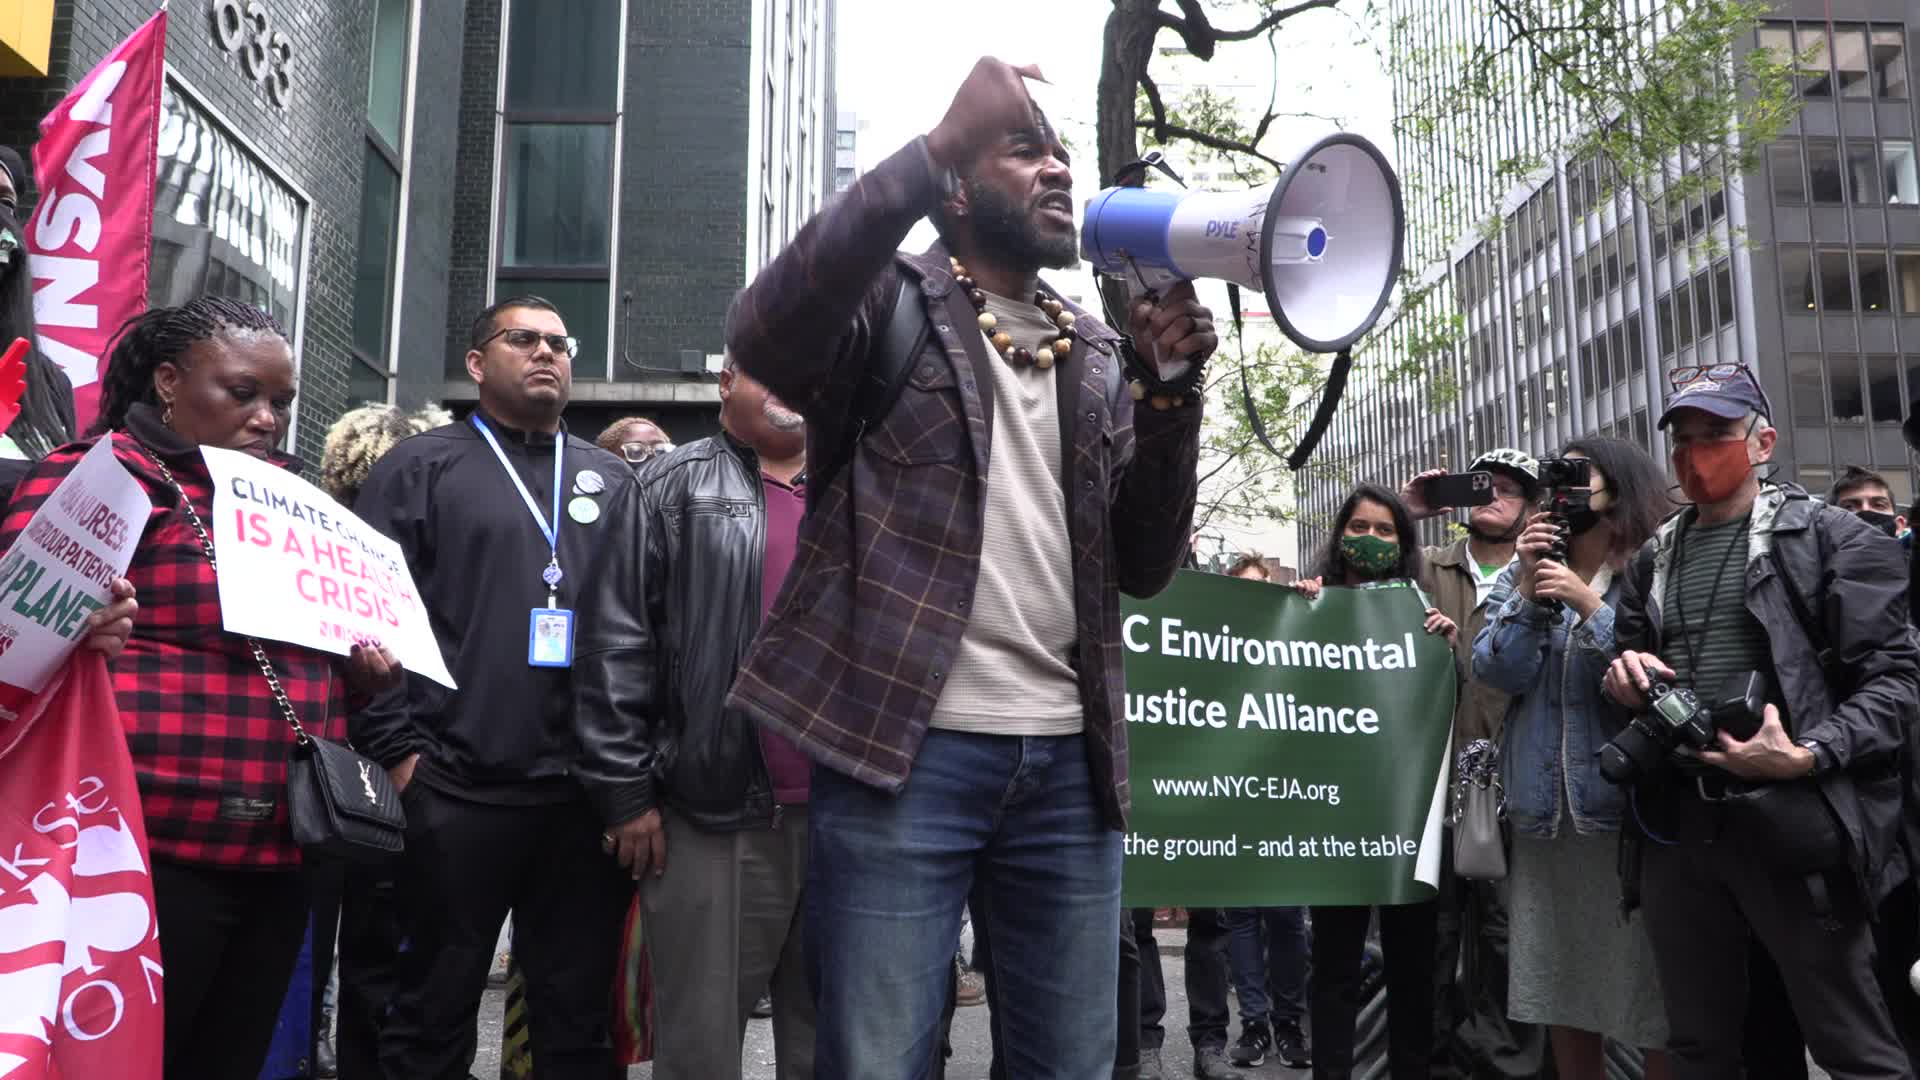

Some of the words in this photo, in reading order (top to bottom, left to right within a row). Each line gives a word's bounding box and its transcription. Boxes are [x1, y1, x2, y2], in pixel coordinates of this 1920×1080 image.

[1205, 219, 1239, 239] PYLE
[231, 477, 332, 532] CLIMATE
[235, 509, 272, 547] IS
[283, 527, 305, 558] A
[1, 560, 104, 641] PLANET
[296, 568, 399, 627] CRISIS
[1122, 614, 1150, 653] C
[1161, 617, 1417, 670] Environmental
[1123, 687, 1227, 728] ustice
[1237, 693, 1380, 734] Alliance
[1152, 775, 1341, 806] www.NYC-EJA.org
[1122, 831, 1159, 856] the
[1163, 833, 1237, 861] ground
[1258, 834, 1294, 857] and
[1298, 836, 1319, 857] at
[1321, 834, 1356, 857] the
[1359, 834, 1417, 857] table
